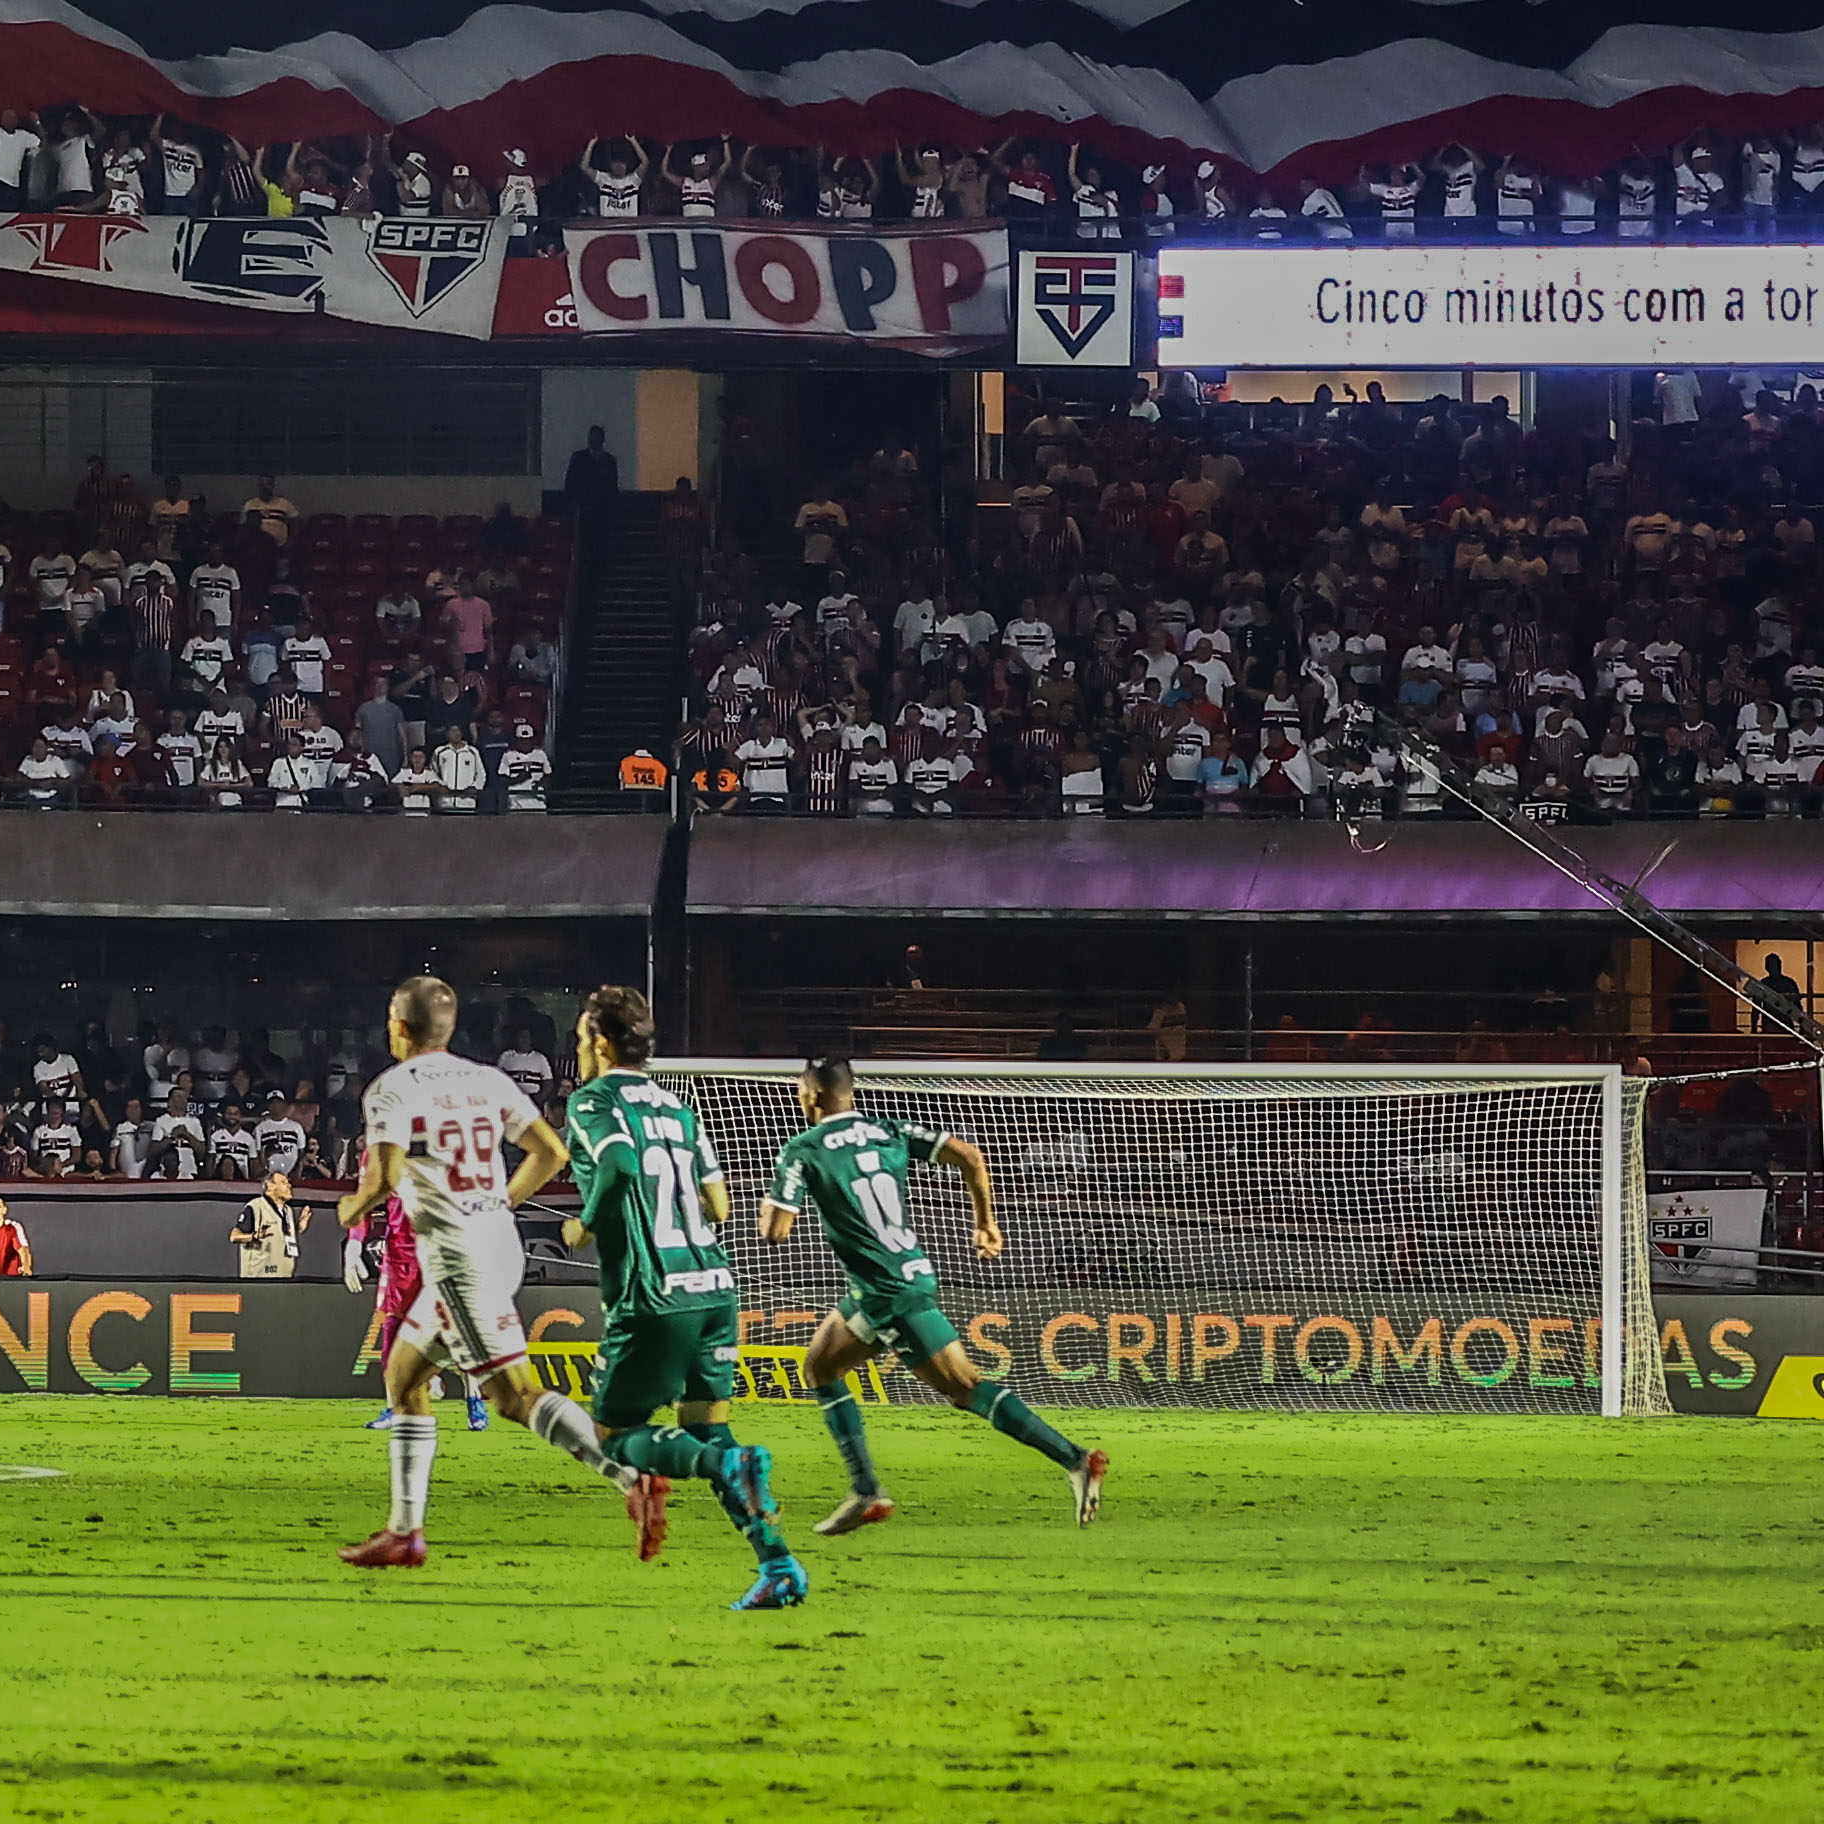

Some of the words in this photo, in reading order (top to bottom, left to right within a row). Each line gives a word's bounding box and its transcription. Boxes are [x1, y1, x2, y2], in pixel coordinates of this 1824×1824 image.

[378, 224, 480, 249] SPFC
[579, 232, 988, 332] CHOPP
[1315, 276, 1427, 326] Cinco
[1445, 279, 1607, 326] minutos
[1622, 286, 1707, 325] com
[1723, 287, 1746, 325] a
[632, 773, 656, 785] 145
[437, 1115, 495, 1194] 29
[1653, 1219, 1710, 1238] SPFC
[1039, 1312, 1756, 1391] CRIPTOMOEAS
